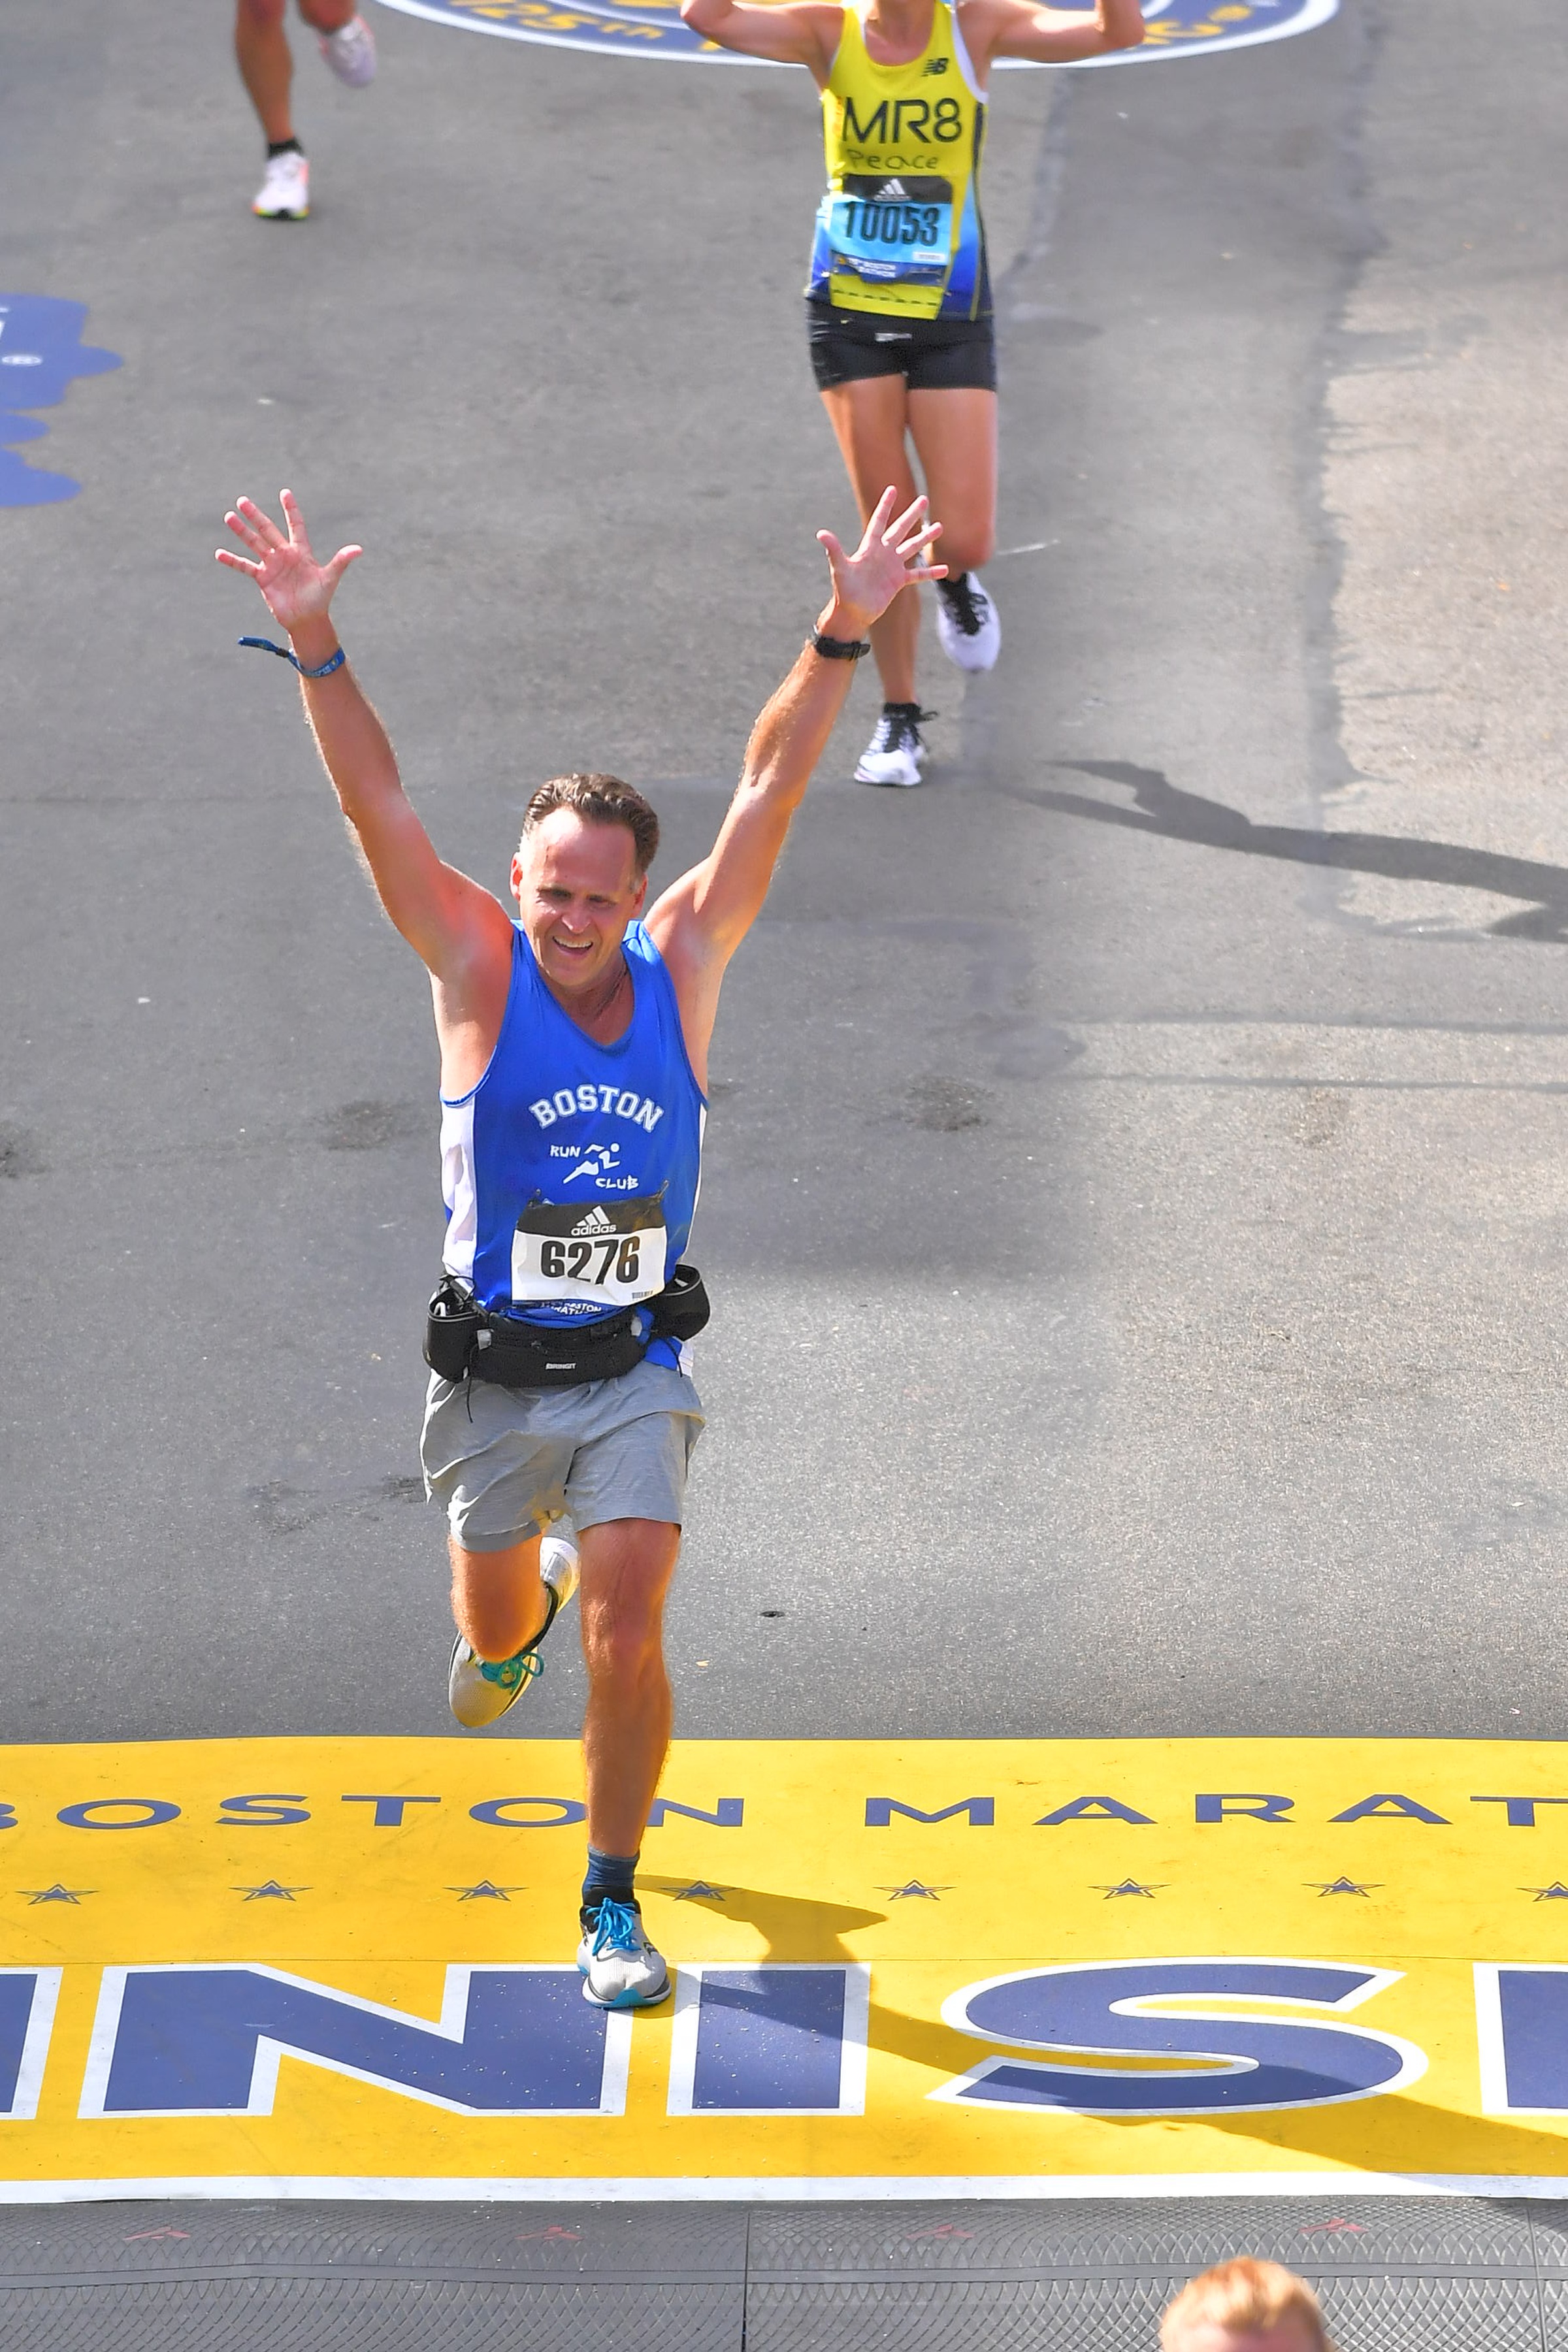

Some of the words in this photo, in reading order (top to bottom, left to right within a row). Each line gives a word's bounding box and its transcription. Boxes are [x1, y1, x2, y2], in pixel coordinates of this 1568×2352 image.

[843, 97, 962, 144] MR8
[847, 149, 939, 170] Peace
[845, 201, 940, 246] 10053
[529, 1084, 664, 1133] BOSTON
[550, 1145, 581, 1158] RUN
[595, 1175, 639, 1190] CLUB
[570, 1224, 617, 1235] adidas
[541, 1235, 640, 1285] 6276
[0, 1794, 743, 1829] OSTON
[865, 1793, 1568, 1827] MARAT
